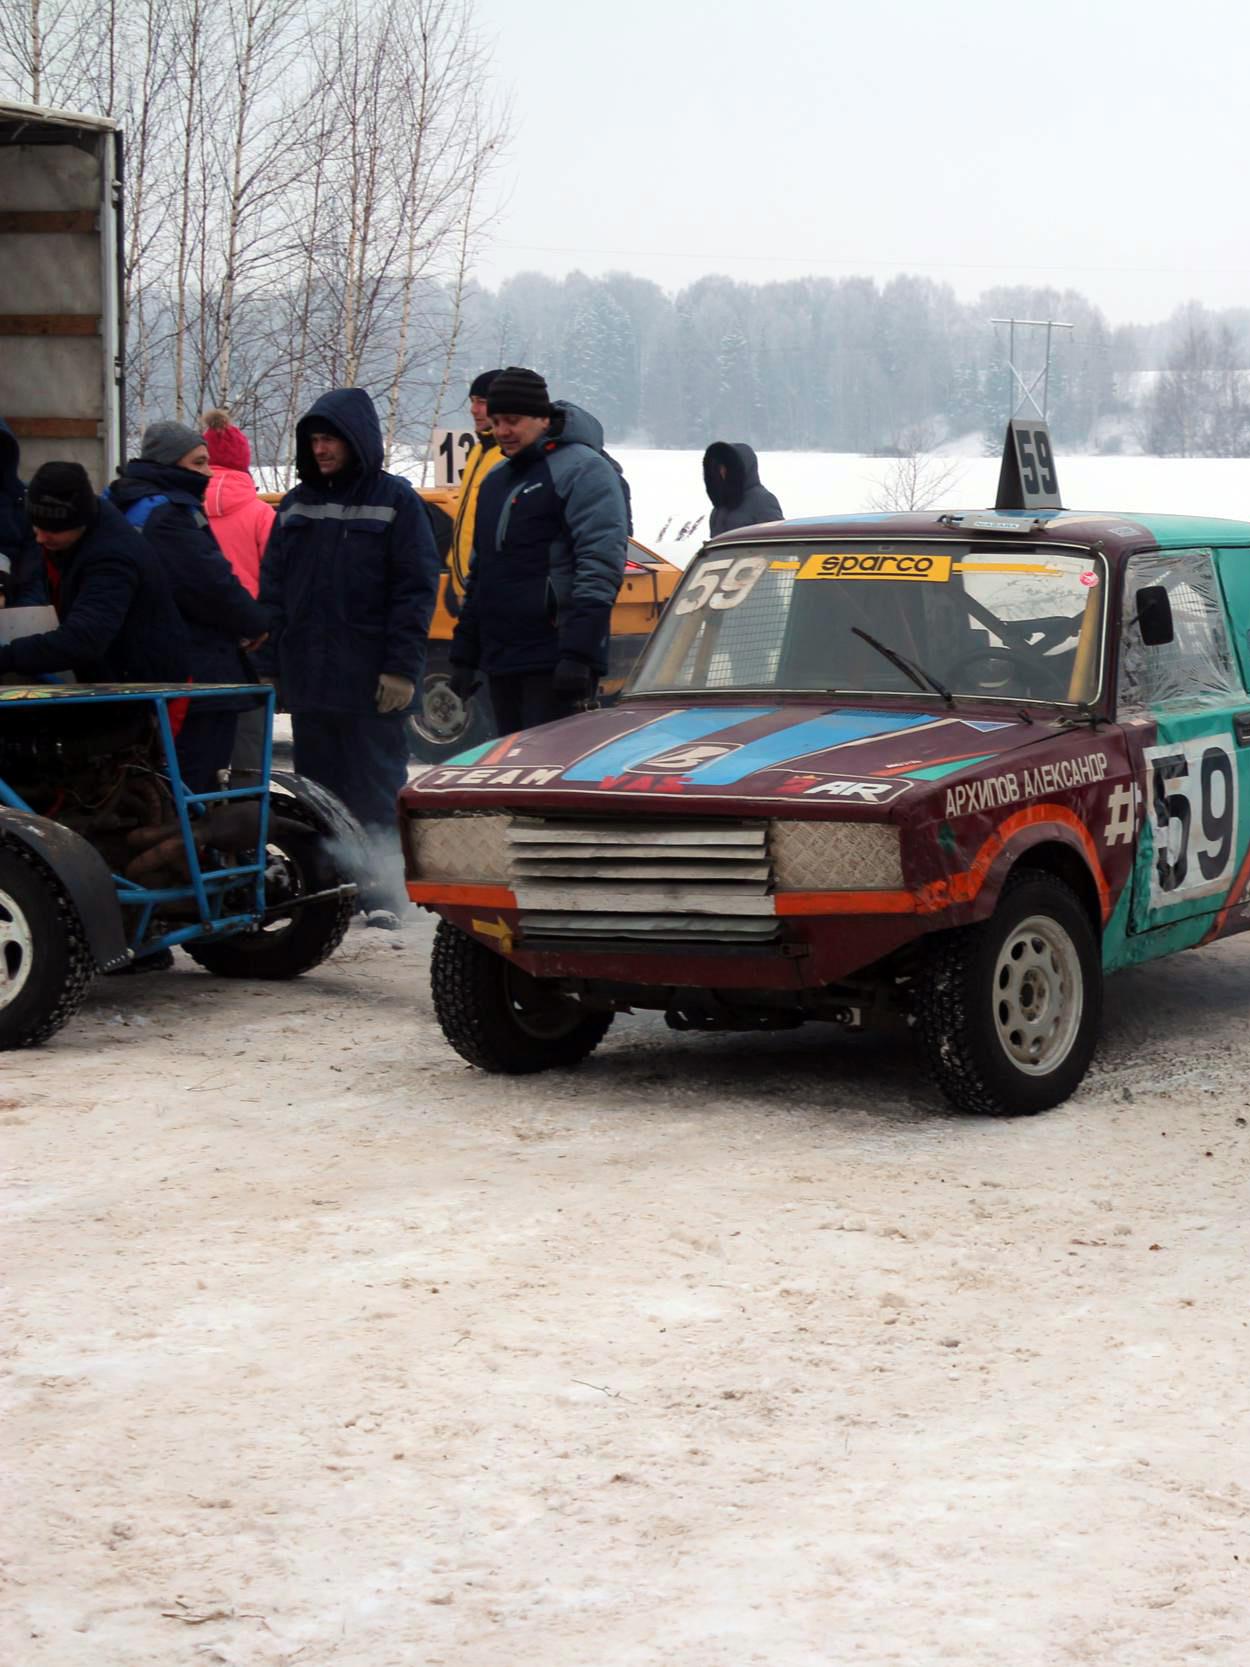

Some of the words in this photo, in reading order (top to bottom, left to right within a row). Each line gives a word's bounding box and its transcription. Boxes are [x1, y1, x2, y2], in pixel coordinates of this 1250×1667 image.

[1015, 429, 1057, 495] 59
[674, 555, 768, 616] 59
[821, 554, 934, 577] sparco
[432, 768, 564, 786] TEAM
[945, 773, 1020, 819] АРХИПОВ
[1024, 752, 1108, 798] АЛЕКСАНДР
